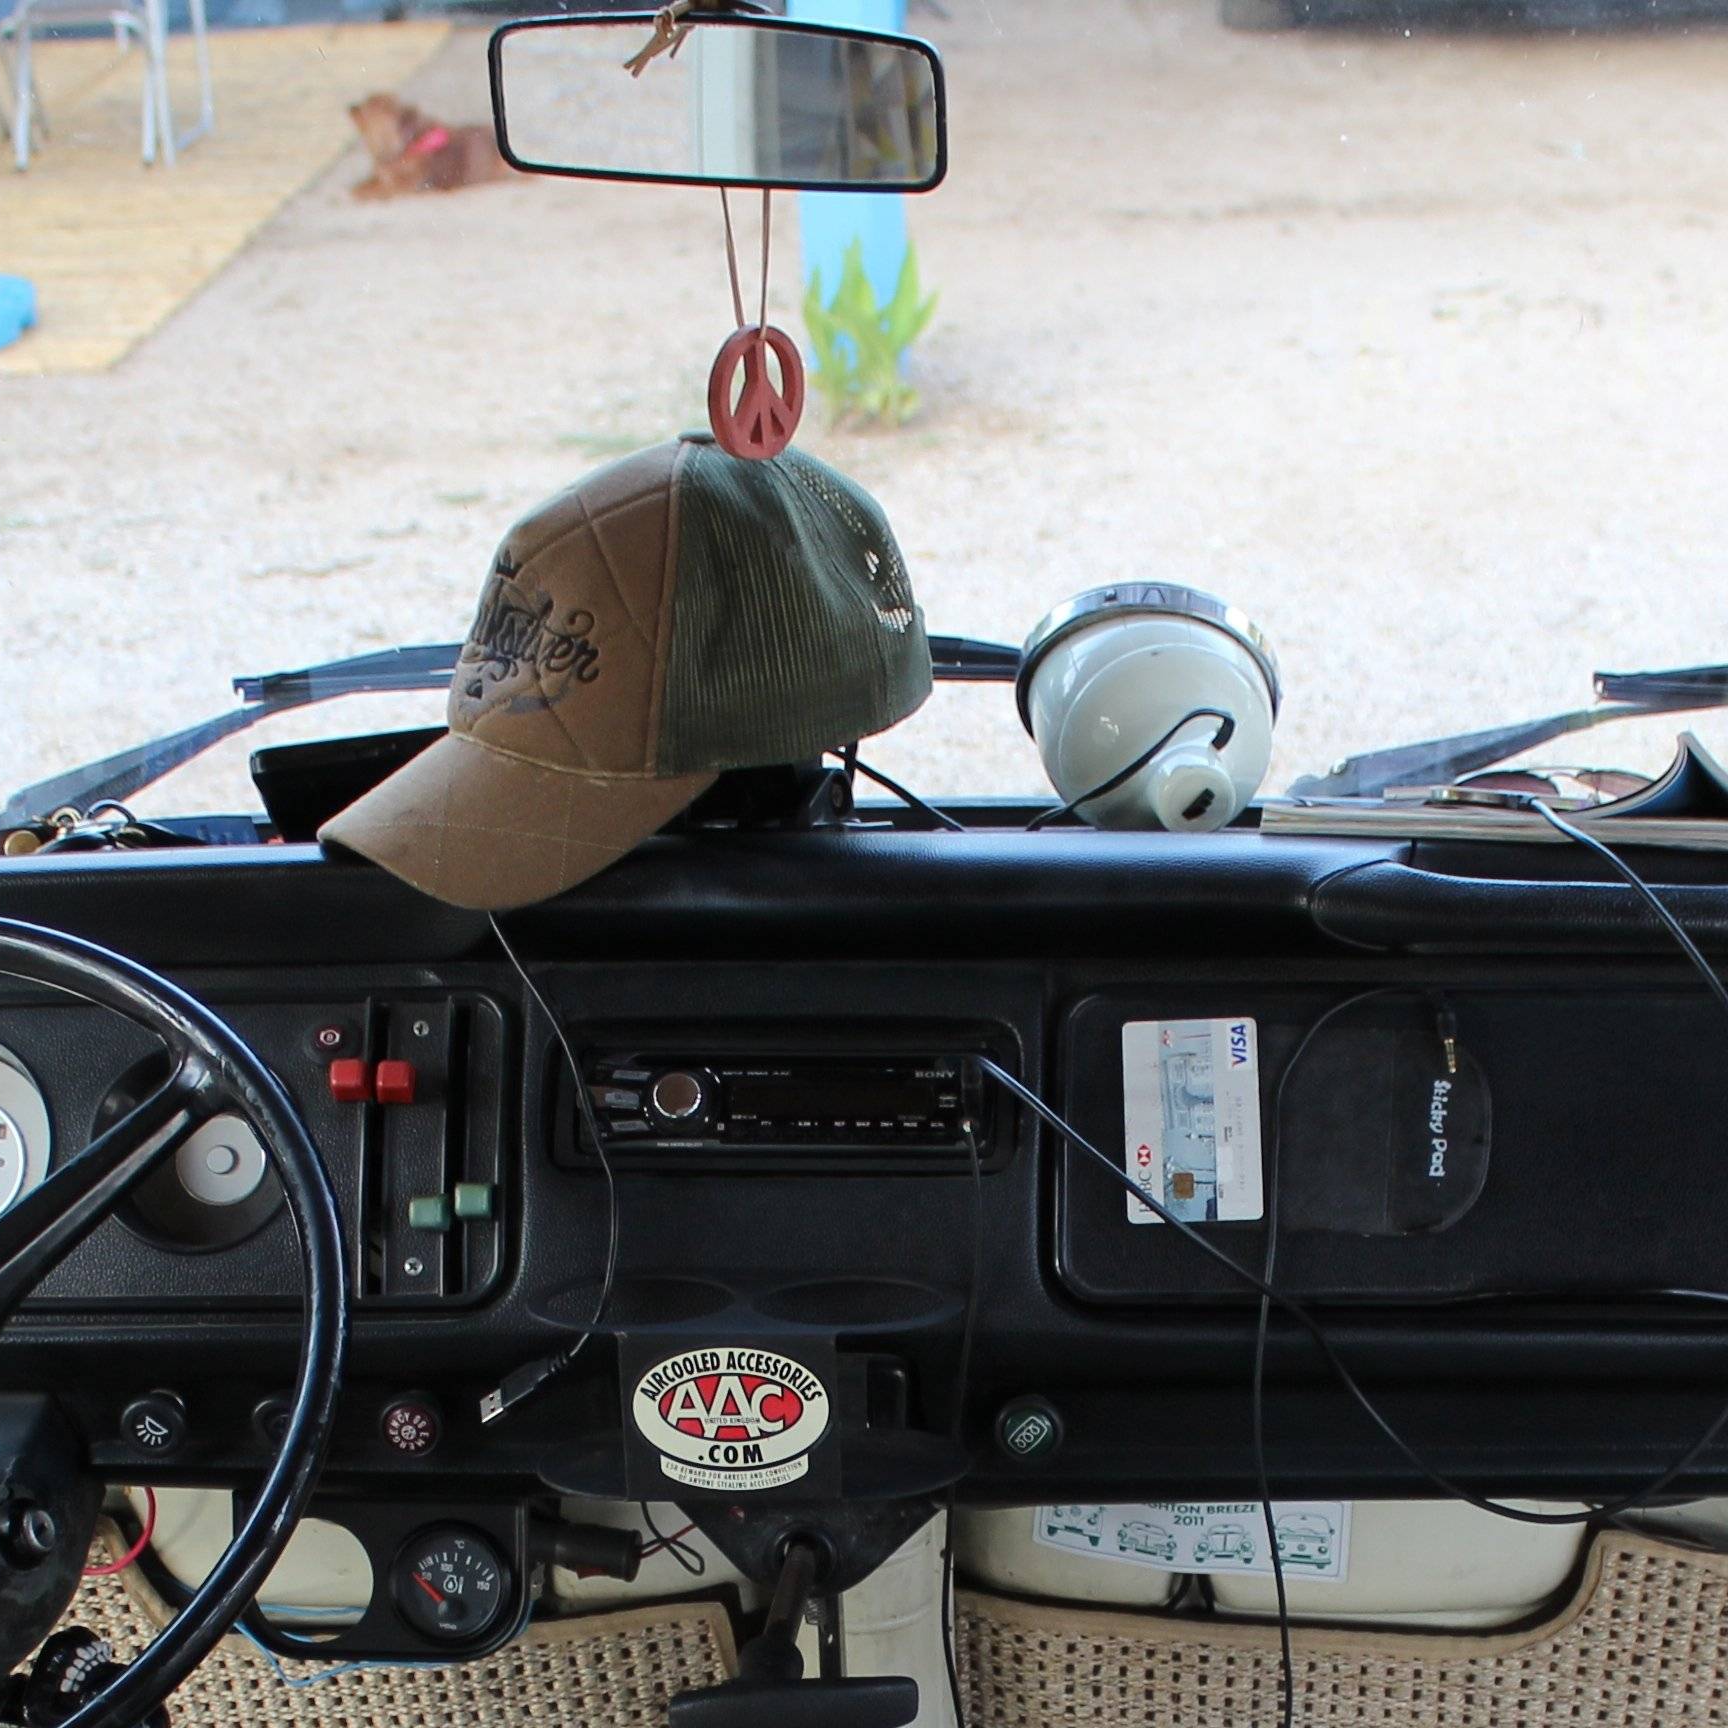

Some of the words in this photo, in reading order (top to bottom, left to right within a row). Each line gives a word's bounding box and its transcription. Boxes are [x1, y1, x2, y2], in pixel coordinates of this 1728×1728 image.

[1230, 1024, 1248, 1067] VISA
[914, 1070, 955, 1078] SONY
[1429, 1079, 1452, 1134] Sticky
[1429, 1138, 1448, 1177] Pad
[640, 1351, 721, 1402] AIRCOOLED
[726, 1351, 824, 1402] ACCESSORIES
[667, 1376, 785, 1439] AAC
[698, 1444, 763, 1464] .COM
[749, 1471, 763, 1480] AND
[1206, 1503, 1258, 1514] BREEZE
[1173, 1515, 1205, 1526] 2011
[477, 1581, 491, 1591] 150
